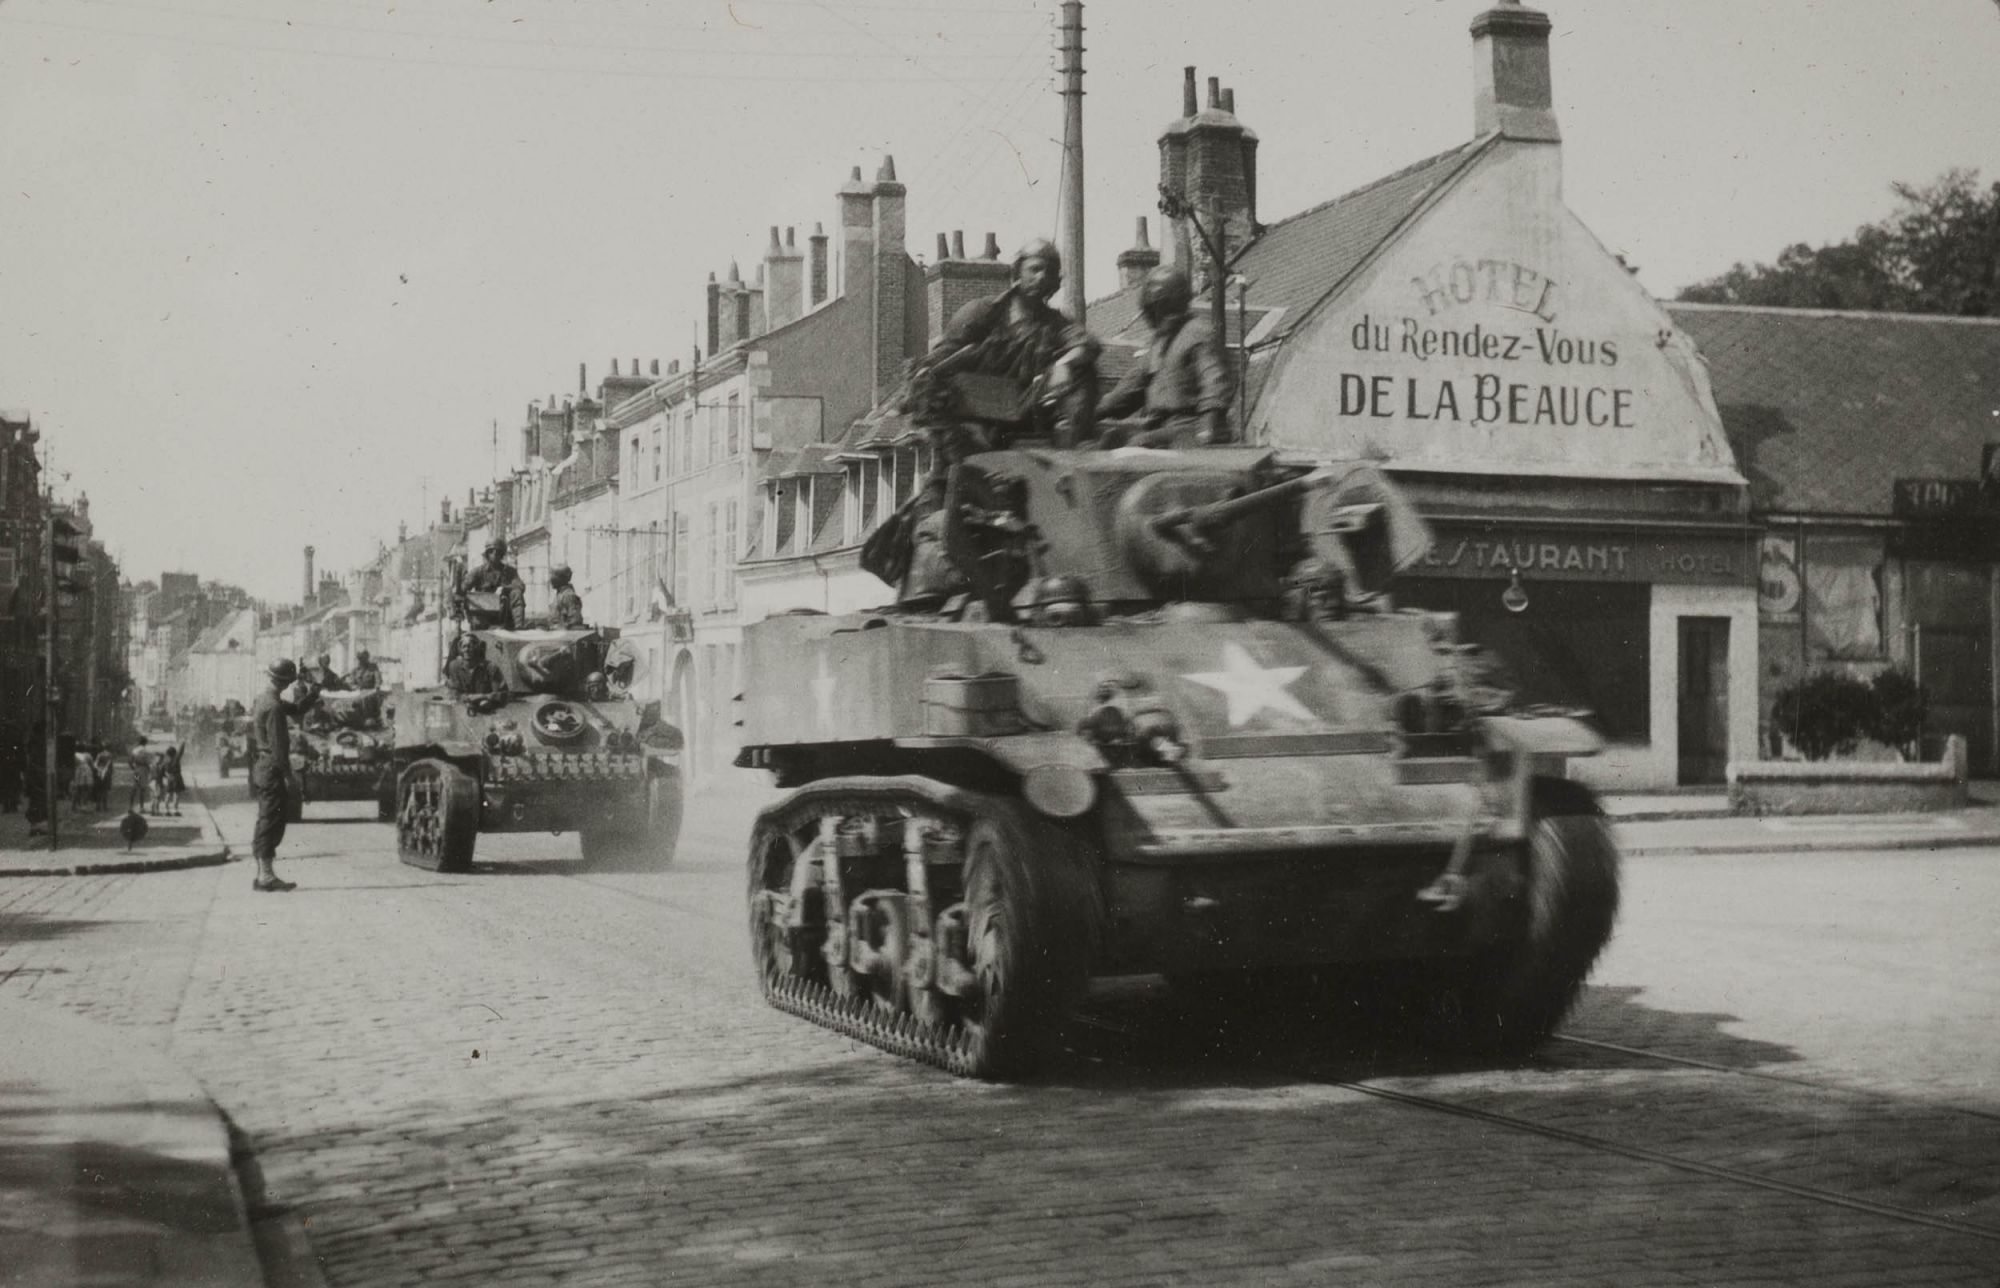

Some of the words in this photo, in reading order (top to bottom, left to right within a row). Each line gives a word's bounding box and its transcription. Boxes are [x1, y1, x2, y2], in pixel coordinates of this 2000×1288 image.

[1352, 314, 1390, 352] du
[1402, 316, 1618, 366] Rendez-Vous
[1339, 373, 1394, 417] DE
[1407, 378, 1461, 421] LA
[1471, 374, 1635, 428] BEAUCE
[1424, 540, 1630, 571] ESTAURANT
